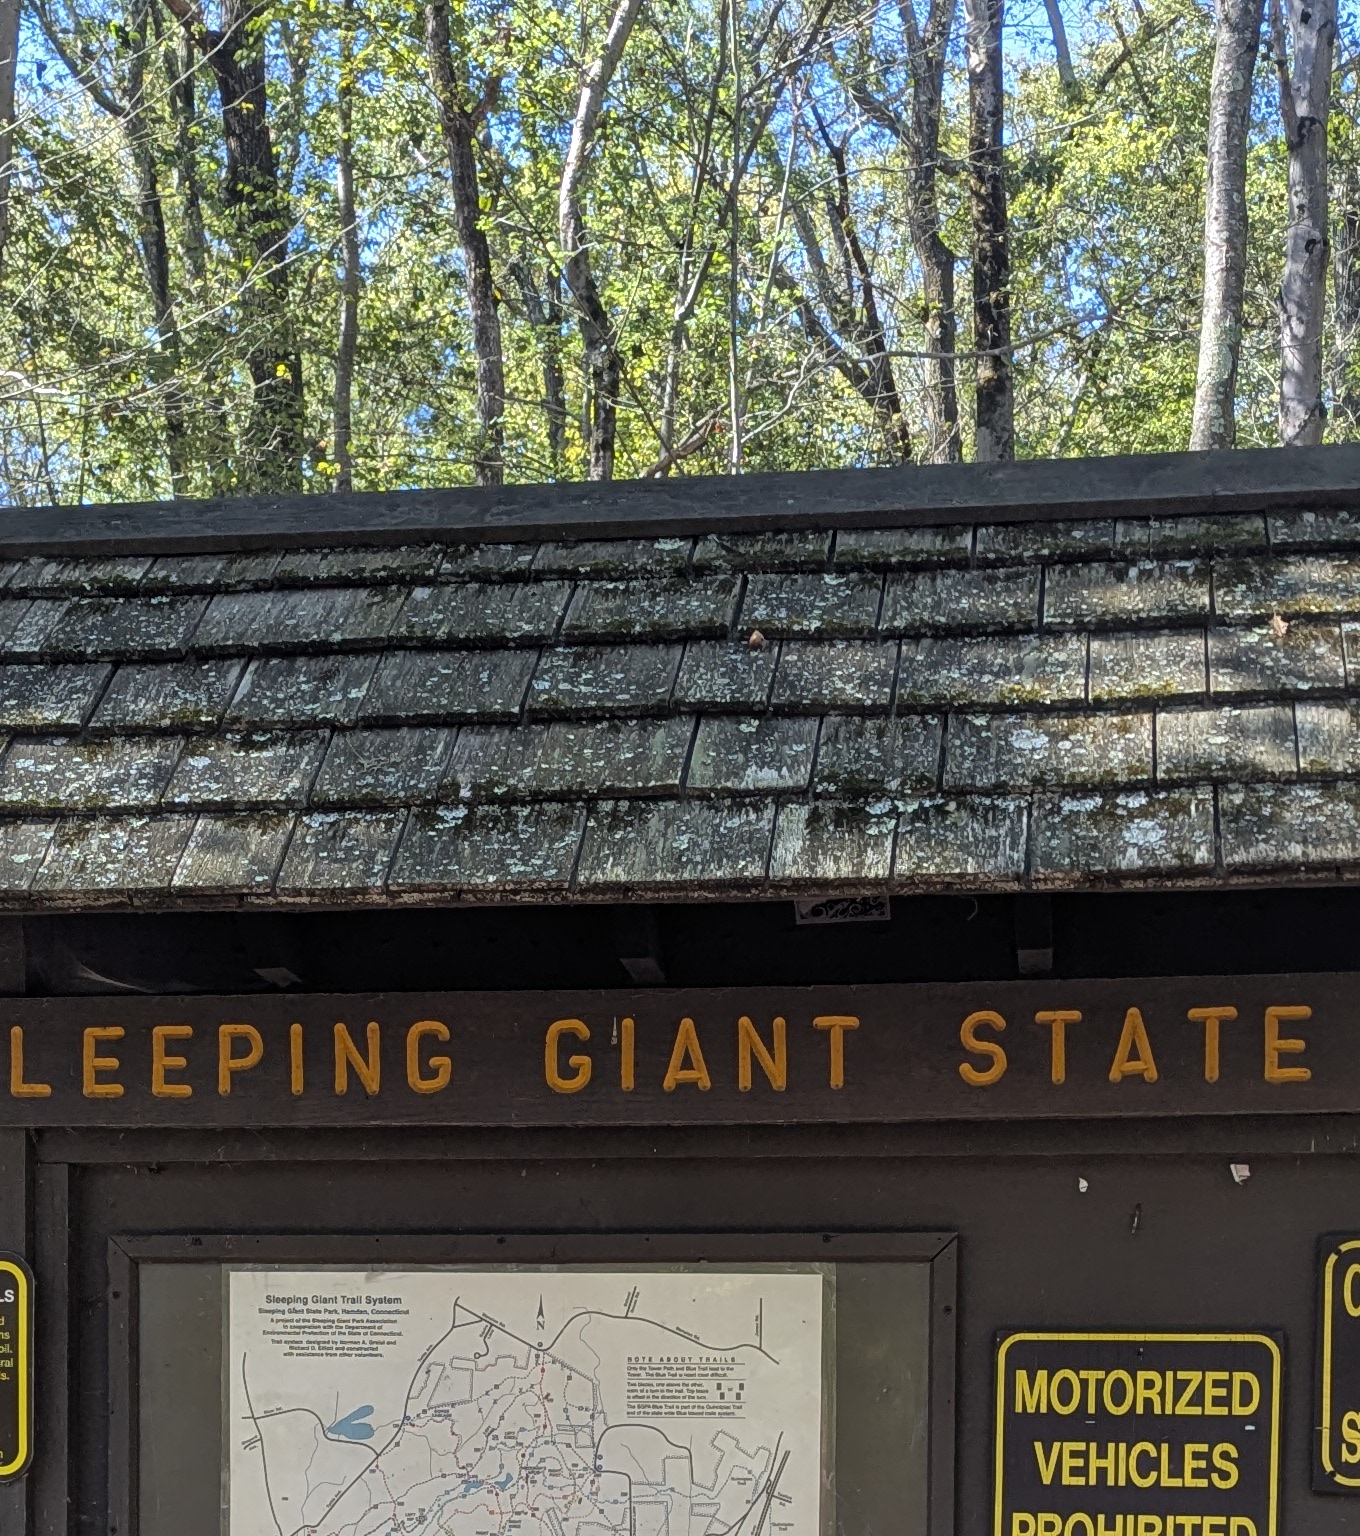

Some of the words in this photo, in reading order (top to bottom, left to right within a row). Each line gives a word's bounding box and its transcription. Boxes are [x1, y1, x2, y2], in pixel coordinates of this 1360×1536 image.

[545, 1015, 861, 1094] GIANT
[959, 1006, 1312, 1086] STATE
[266, 1295, 308, 1306] Sleeping
[312, 1295, 338, 1304] Giant
[341, 1296, 362, 1304] Trail
[365, 1296, 402, 1306] System
[537, 1322, 545, 1330] N
[1014, 1369, 1260, 1416] MOTORIZED
[1034, 1441, 1239, 1489] VEHICLES
